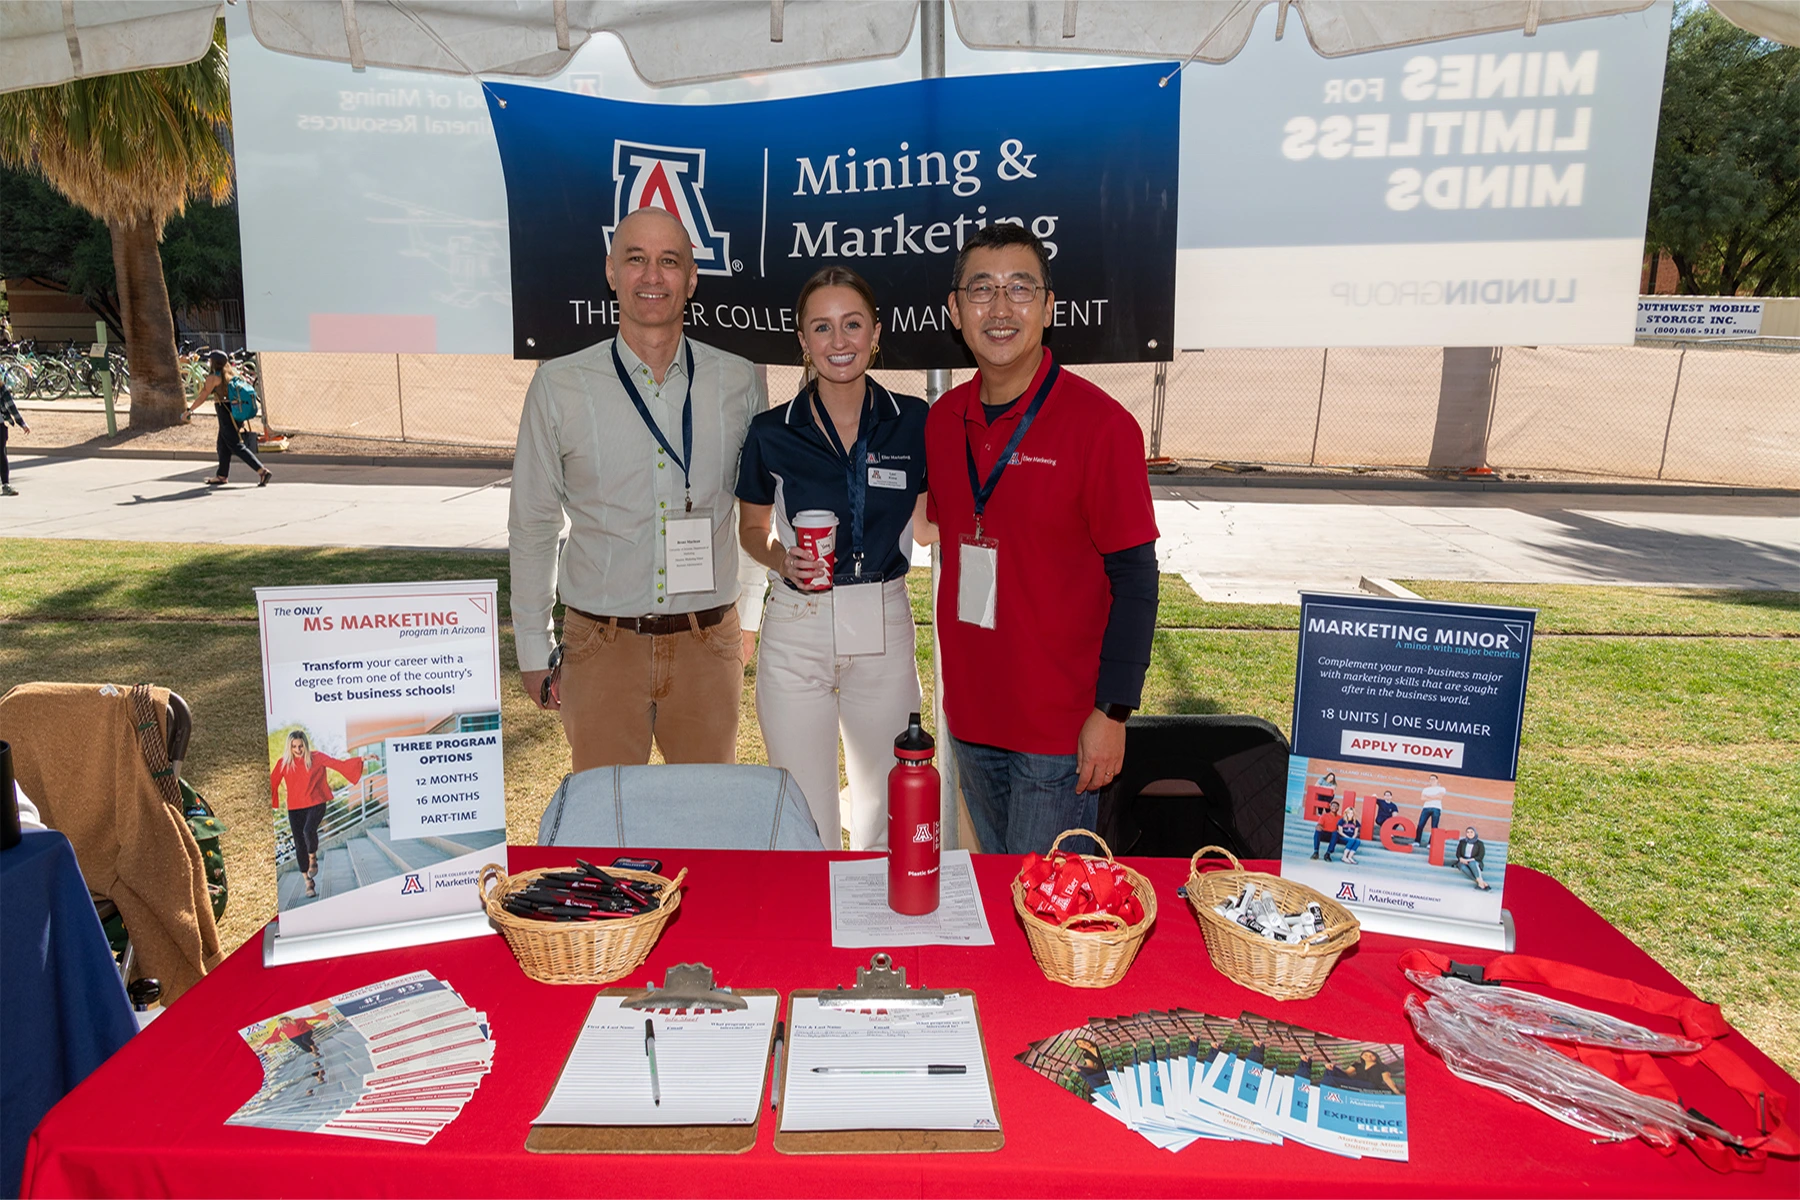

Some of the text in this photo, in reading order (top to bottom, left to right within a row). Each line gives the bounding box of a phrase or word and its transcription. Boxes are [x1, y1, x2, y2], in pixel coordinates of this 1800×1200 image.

[793, 138, 1037, 197] Mining &
[788, 205, 1059, 260] Marketig
[1637, 303, 1760, 313] OUTHWEST MOBILE
[715, 304, 800, 333] COLLE
[1646, 315, 1737, 325] STORAGE INC.
[1654, 327, 1678, 335] (800)
[274, 606, 323, 616] The ONLY
[303, 611, 459, 632] MS MARKETING
[400, 625, 486, 639] program in Arizona
[1308, 618, 1510, 650] MARKETING MINOR
[1395, 640, 1521, 660] A minor with major benefits
[302, 654, 464, 672] Transform your career with a
[1318, 656, 1503, 683] Complement your non-business major
[294, 667, 473, 689] degree from one of the country's
[1320, 669, 1499, 696] with marketing skills that are sought
[314, 684, 456, 703] best business schools!
[1341, 685, 1471, 706] after in the business world.
[1321, 708, 1491, 737] 18 UNITS ONE SUMMER
[393, 736, 497, 752] THREE PROGRAM
[1351, 738, 1454, 759] APPLY TODAY
[419, 752, 473, 765] OPTIONS
[416, 772, 479, 786] 12 MONTHS
[416, 791, 480, 805] 16 MONTHS
[421, 811, 478, 824] PART-TIME
[1303, 784, 1461, 867] Eller
[1065, 878, 1079, 895] Eller
[1368, 894, 1415, 909] Marketing
[1349, 1100, 1385, 1109] Marketing
[1323, 1109, 1403, 1127] EXPERIENCE
[1357, 1123, 1404, 1134] ELLER.
[1338, 1135, 1378, 1147] Marketing
[1344, 1143, 1404, 1154] Online Program
